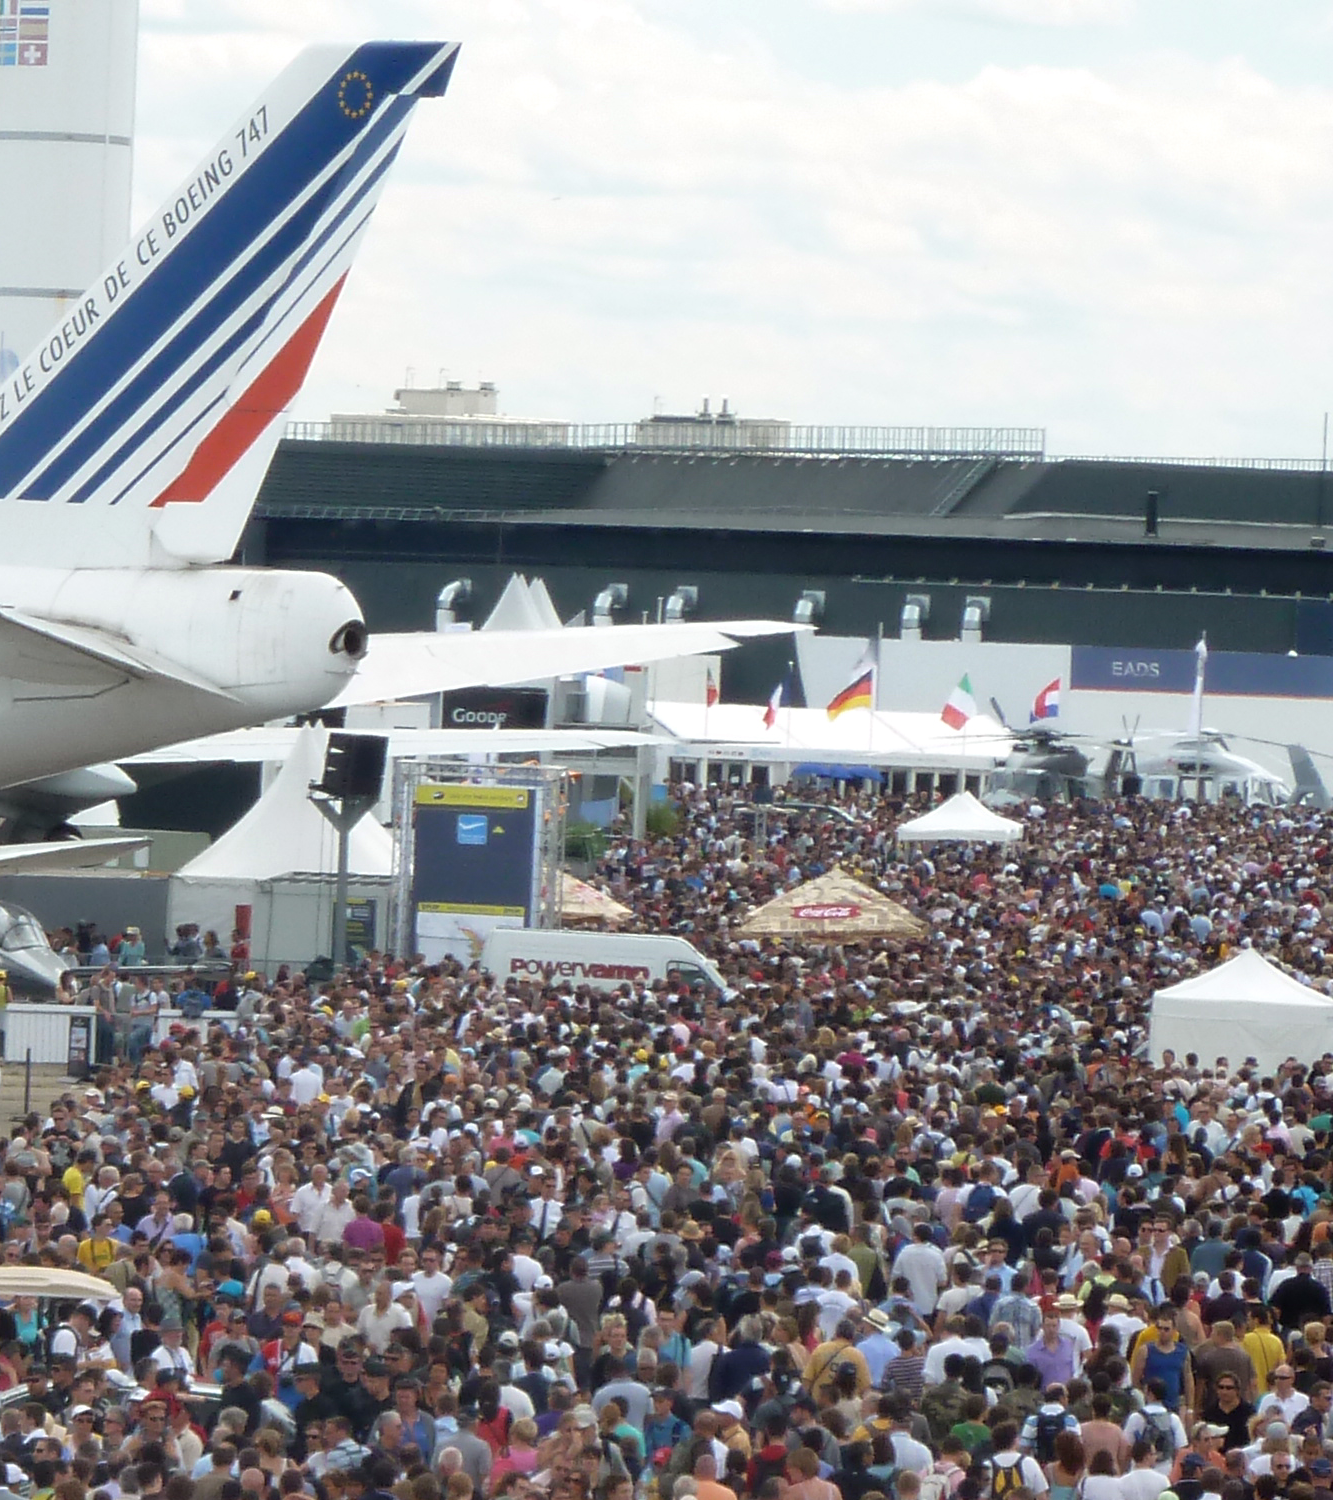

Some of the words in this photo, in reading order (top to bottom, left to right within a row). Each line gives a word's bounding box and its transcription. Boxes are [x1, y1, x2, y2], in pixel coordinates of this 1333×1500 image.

[13, 365, 36, 402] LE
[39, 298, 100, 373] COEUR
[103, 261, 131, 302] DE
[136, 228, 160, 266] CE
[162, 149, 233, 238] BOEING
[236, 105, 269, 158] 747
[1112, 661, 1160, 677] EADS
